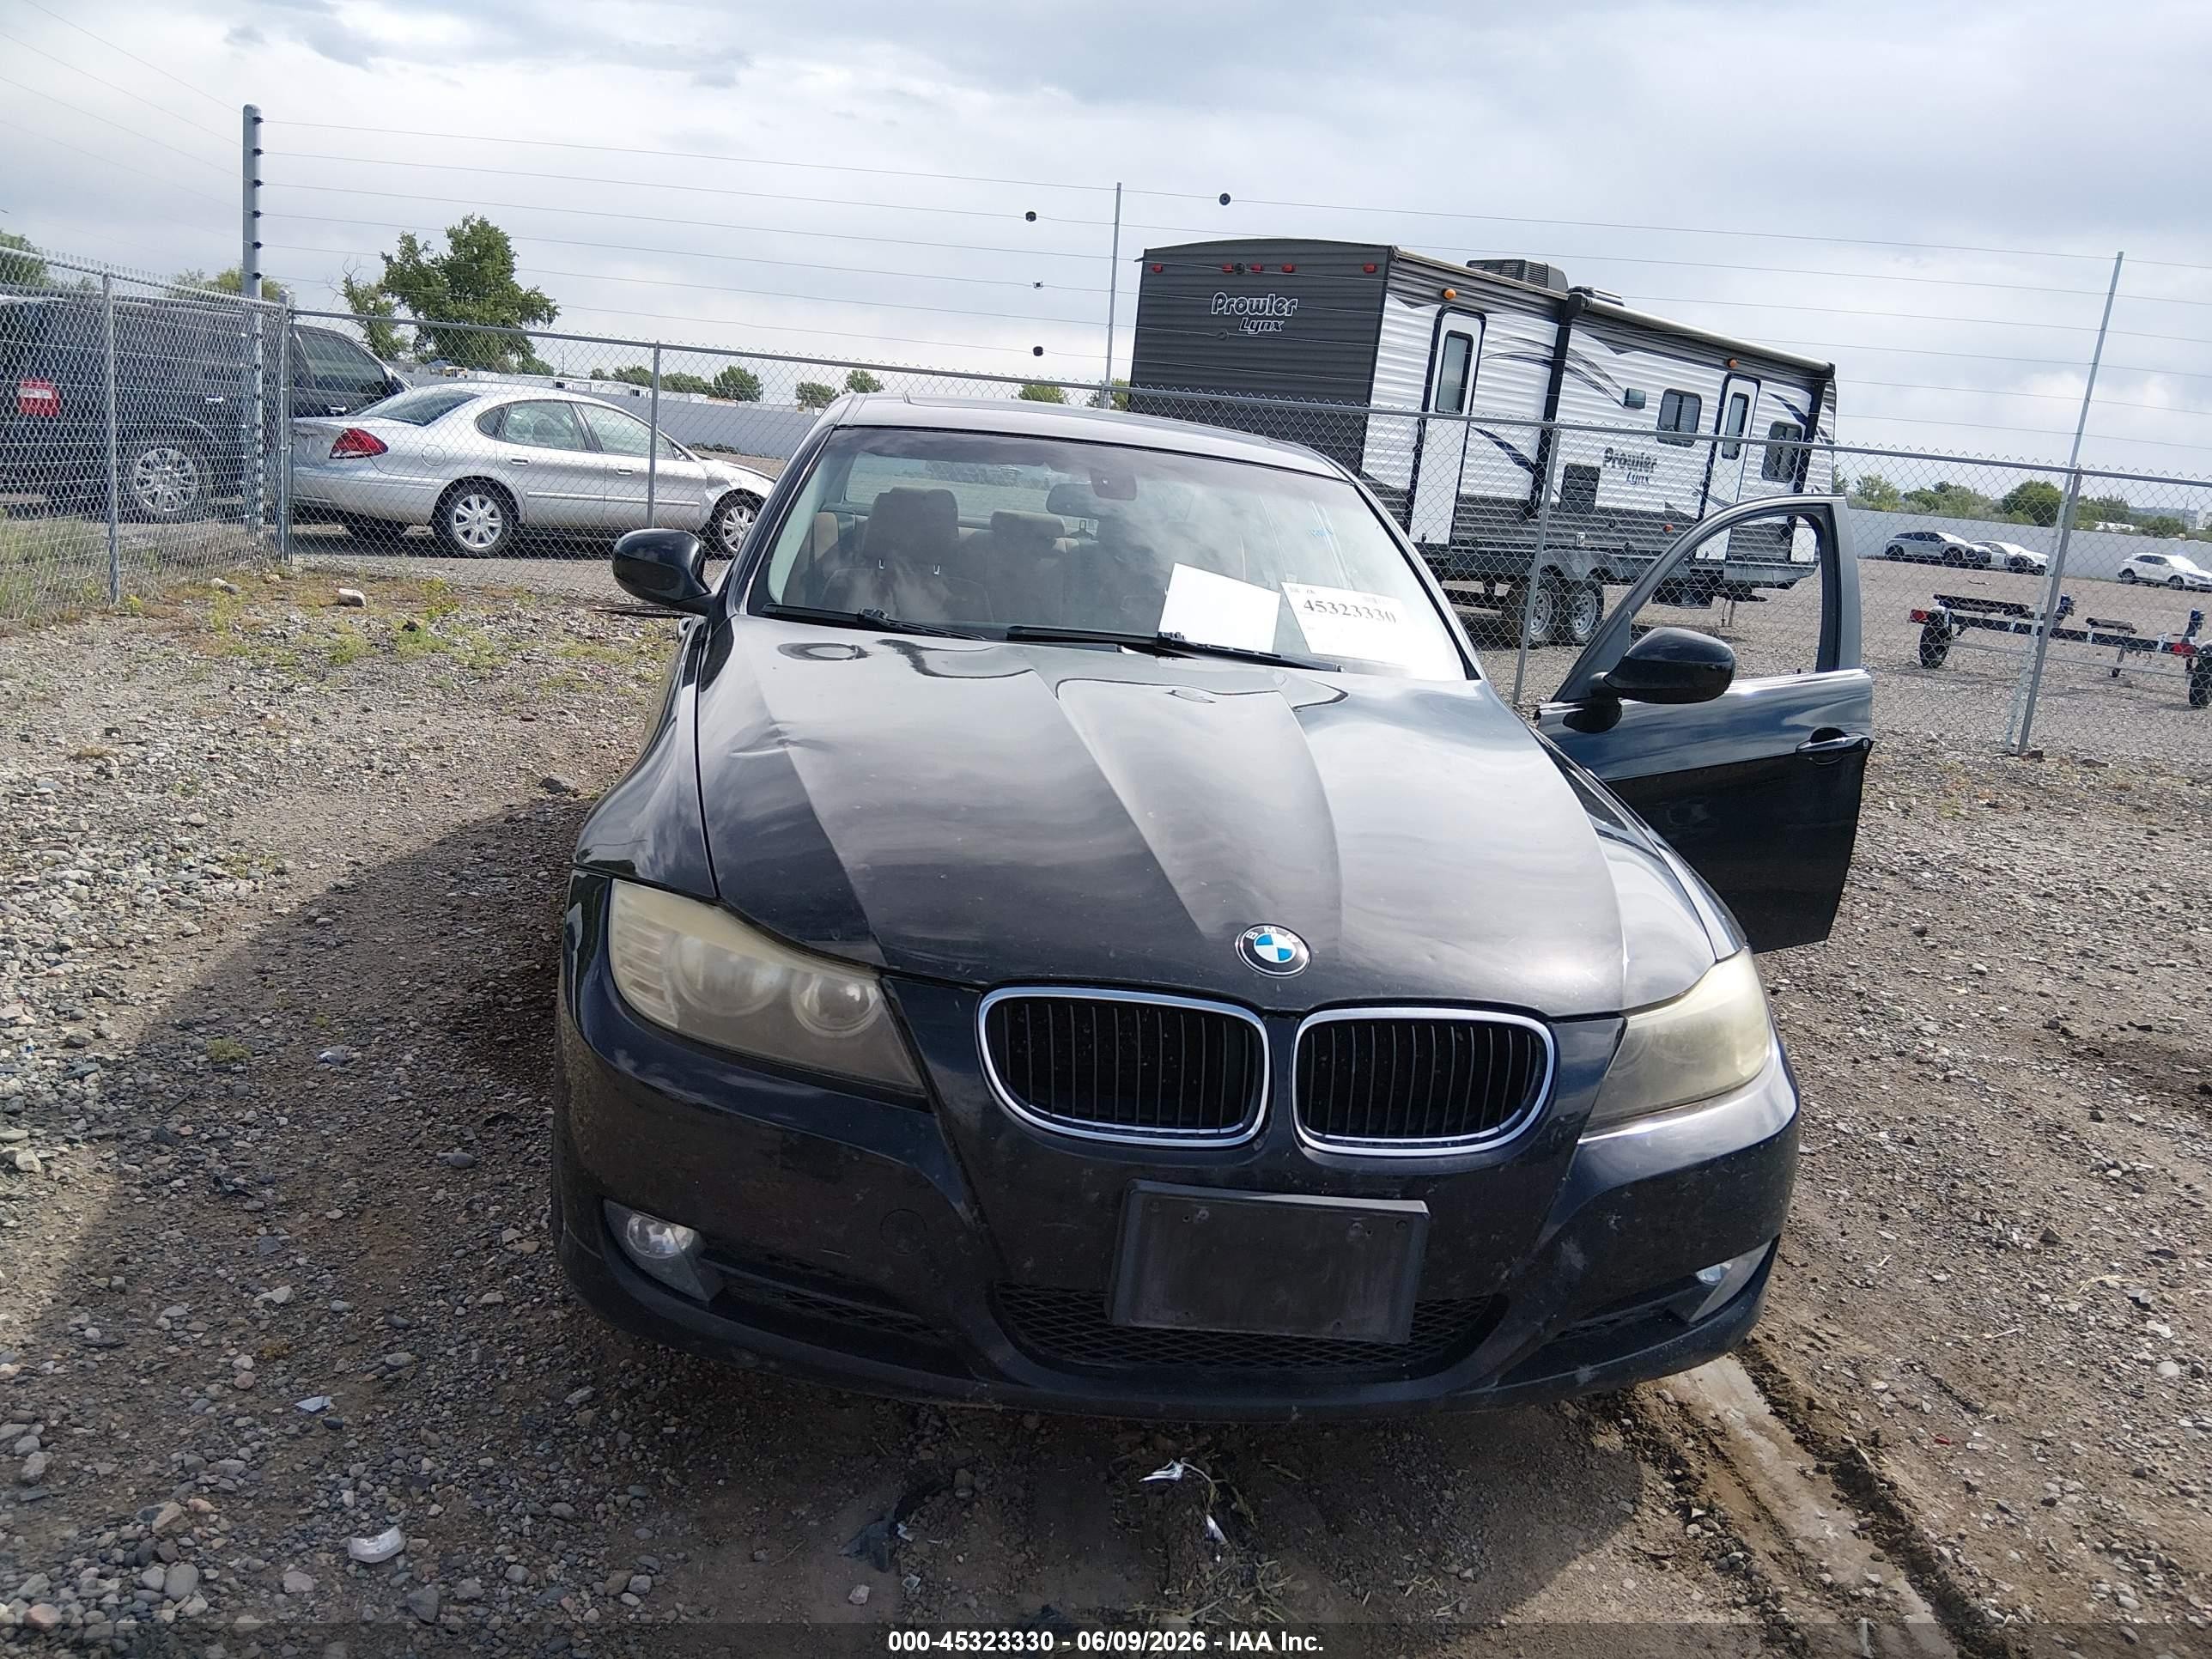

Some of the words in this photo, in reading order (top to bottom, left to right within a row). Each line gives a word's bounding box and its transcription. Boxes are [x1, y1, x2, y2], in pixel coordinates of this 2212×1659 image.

[1211, 291, 1298, 317] Prowler
[1238, 317, 1285, 335] Lynx
[1602, 447, 1658, 473] Prowler
[1626, 471, 1650, 486] Lynx
[1304, 599, 1397, 623] 45323330
[1245, 926, 1300, 944] BMW
